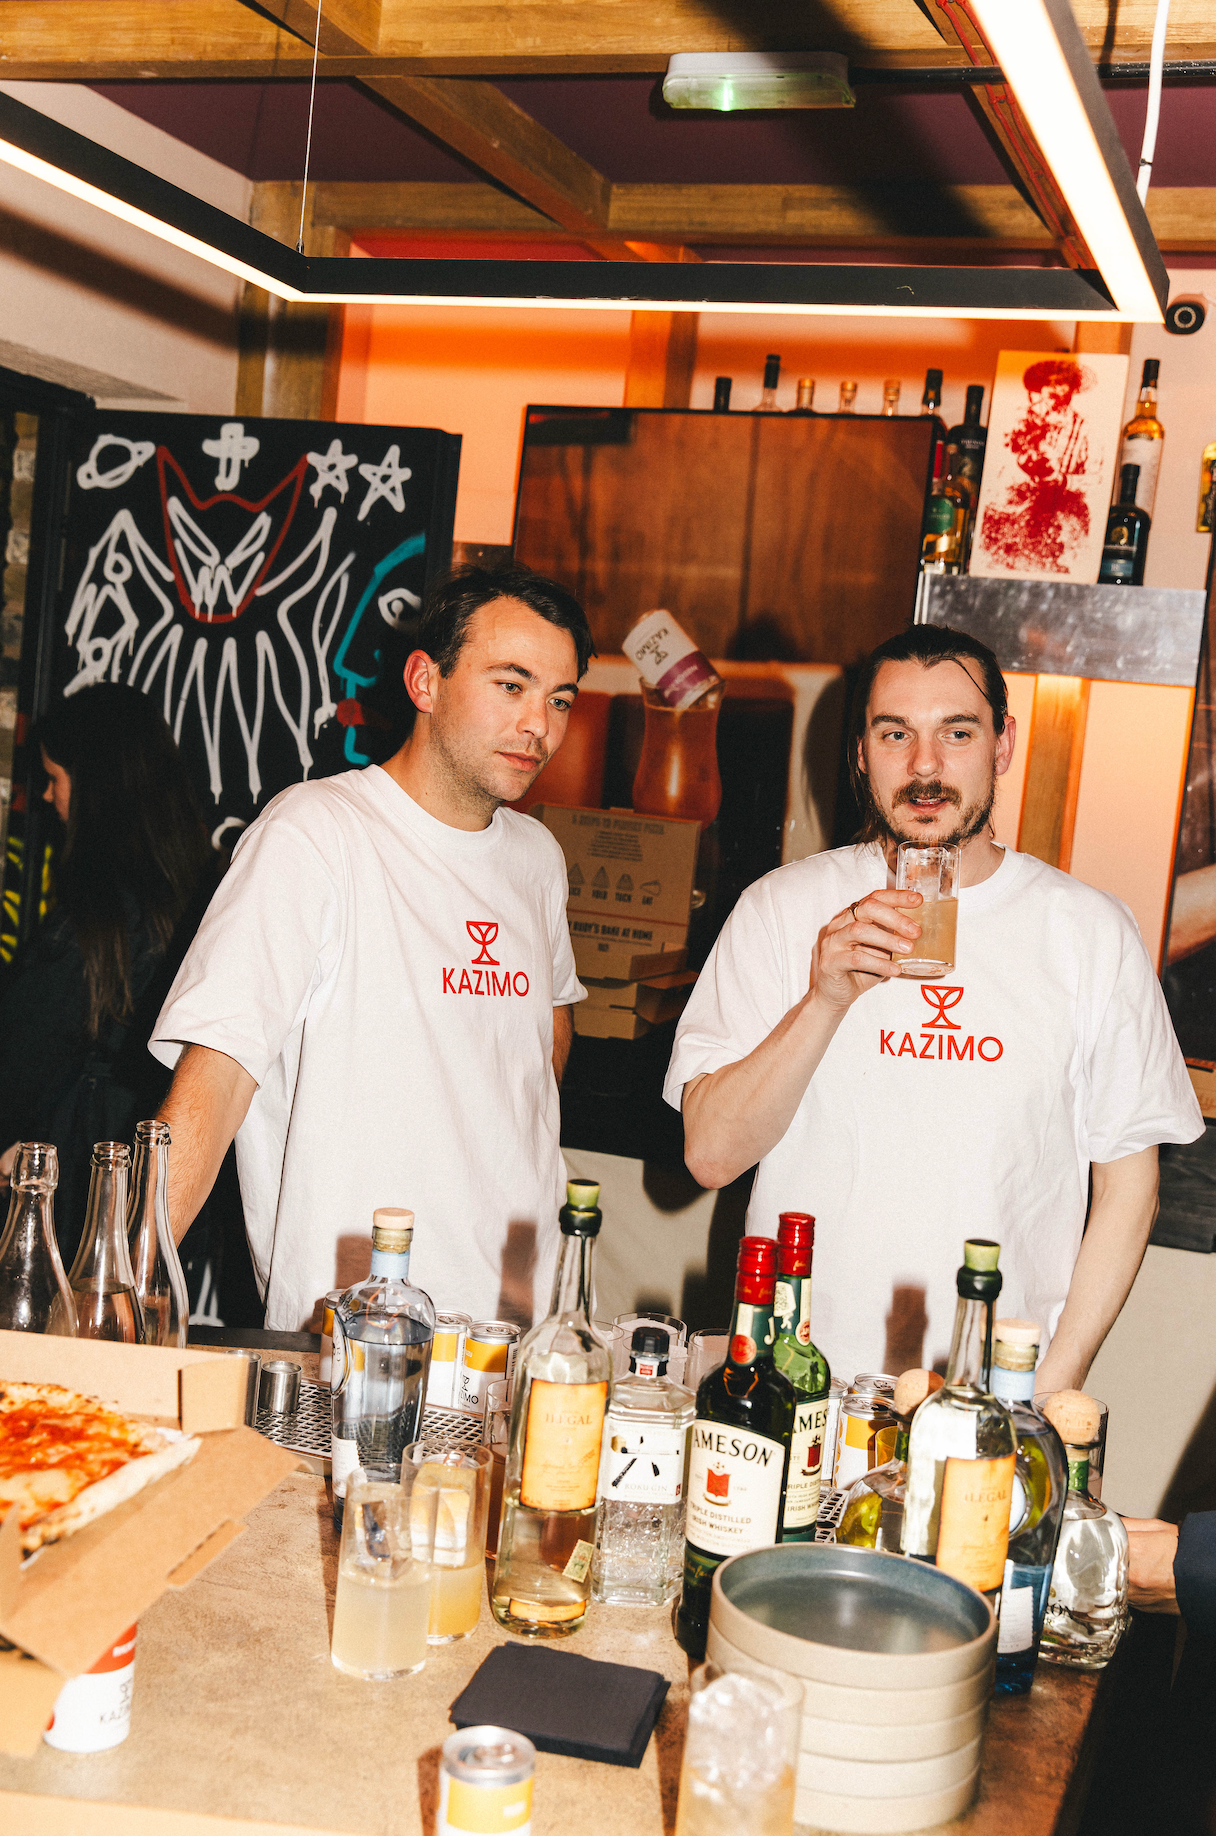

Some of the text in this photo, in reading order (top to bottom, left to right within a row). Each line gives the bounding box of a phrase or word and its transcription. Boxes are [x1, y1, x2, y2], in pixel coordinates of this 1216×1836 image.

[635, 627, 669, 661] KAZIMO
[442, 967, 530, 997] KAZIMO
[880, 1029, 1004, 1062] KAZIMO
[793, 1408, 828, 1434] MES
[710, 1511, 752, 1524] DISTILLED
[787, 1504, 805, 1512] IRISH
[709, 1522, 744, 1534] WHISKEY
